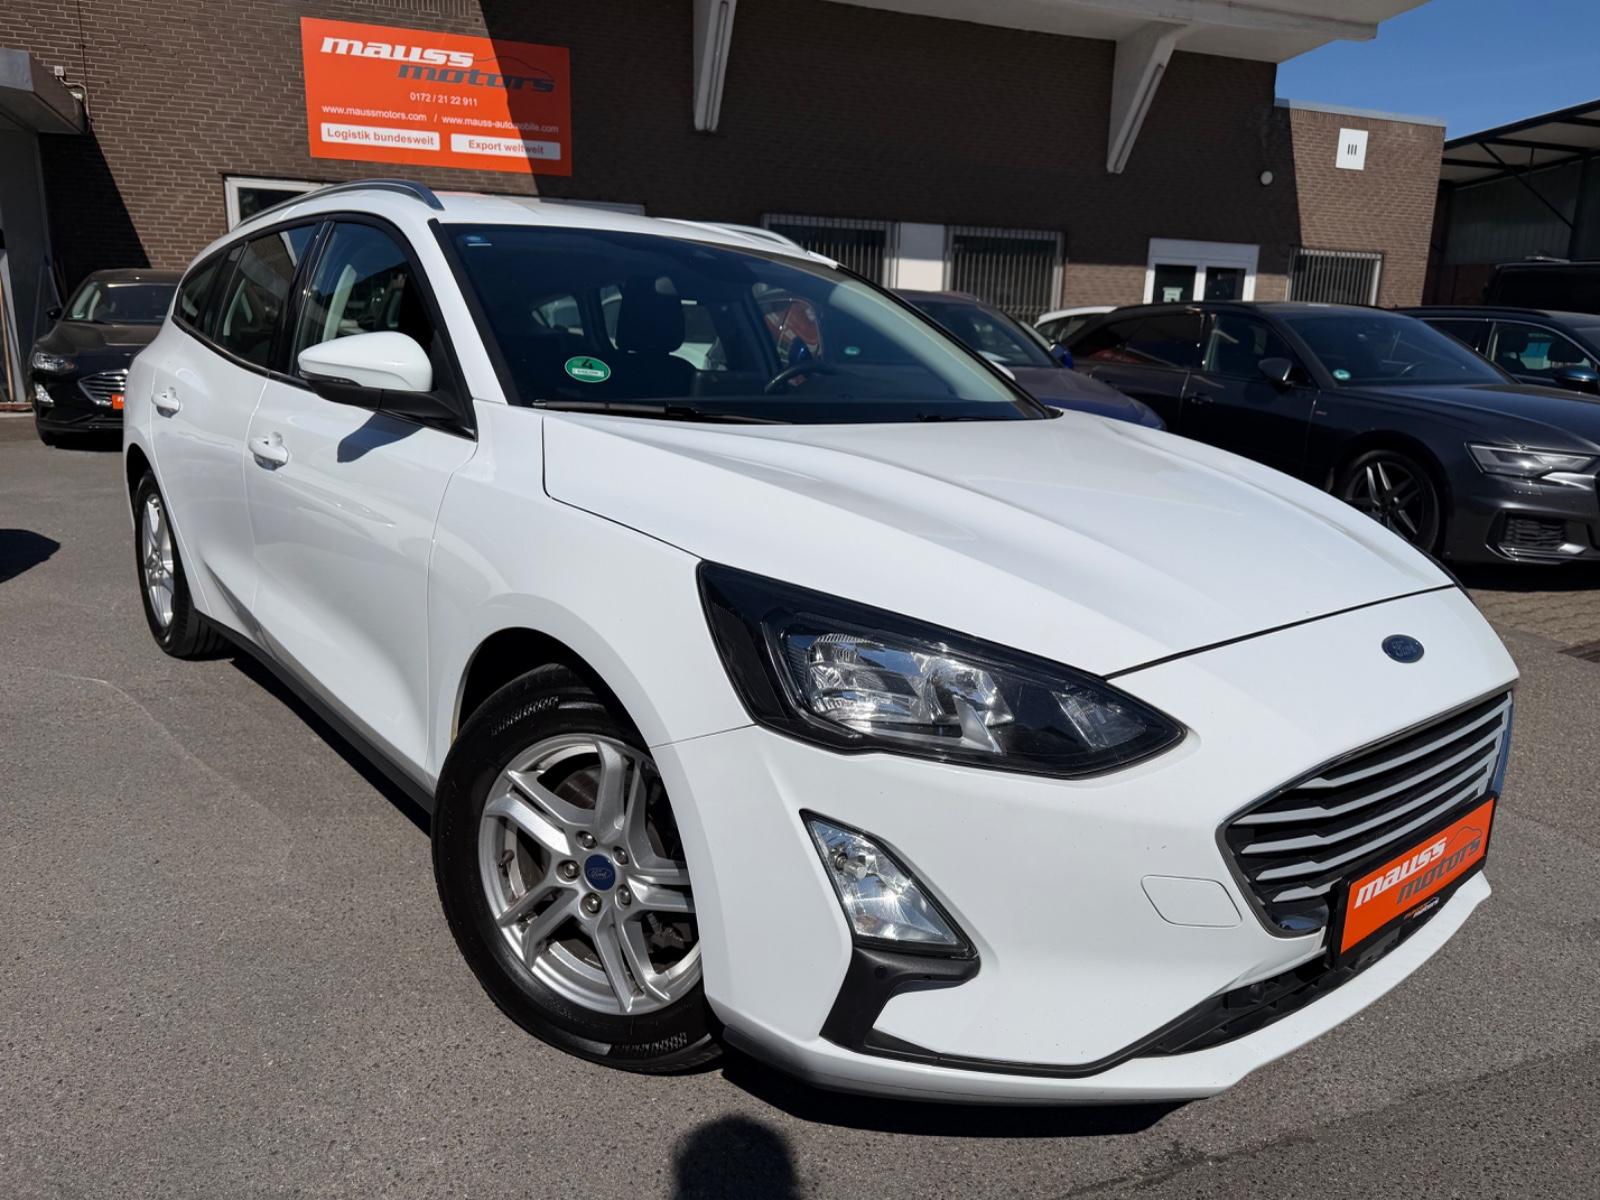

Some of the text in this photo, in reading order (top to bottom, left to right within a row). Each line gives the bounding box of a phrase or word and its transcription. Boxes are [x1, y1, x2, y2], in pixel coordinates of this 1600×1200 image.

[320, 37, 474, 67] mauss
[398, 64, 555, 92] motors
[409, 92, 431, 103] 0172
[438, 94, 448, 104] 21
[450, 96, 461, 105] 22
[463, 97, 478, 107] 911
[321, 105, 427, 121] www.maussmotors.com
[441, 116, 560, 133] www.mauss-automobile.com
[327, 128, 434, 146] Logistik bundesweit
[468, 139, 544, 155] Export weltweit
[1354, 837, 1447, 909] mauss
[1397, 839, 1481, 903] motors
